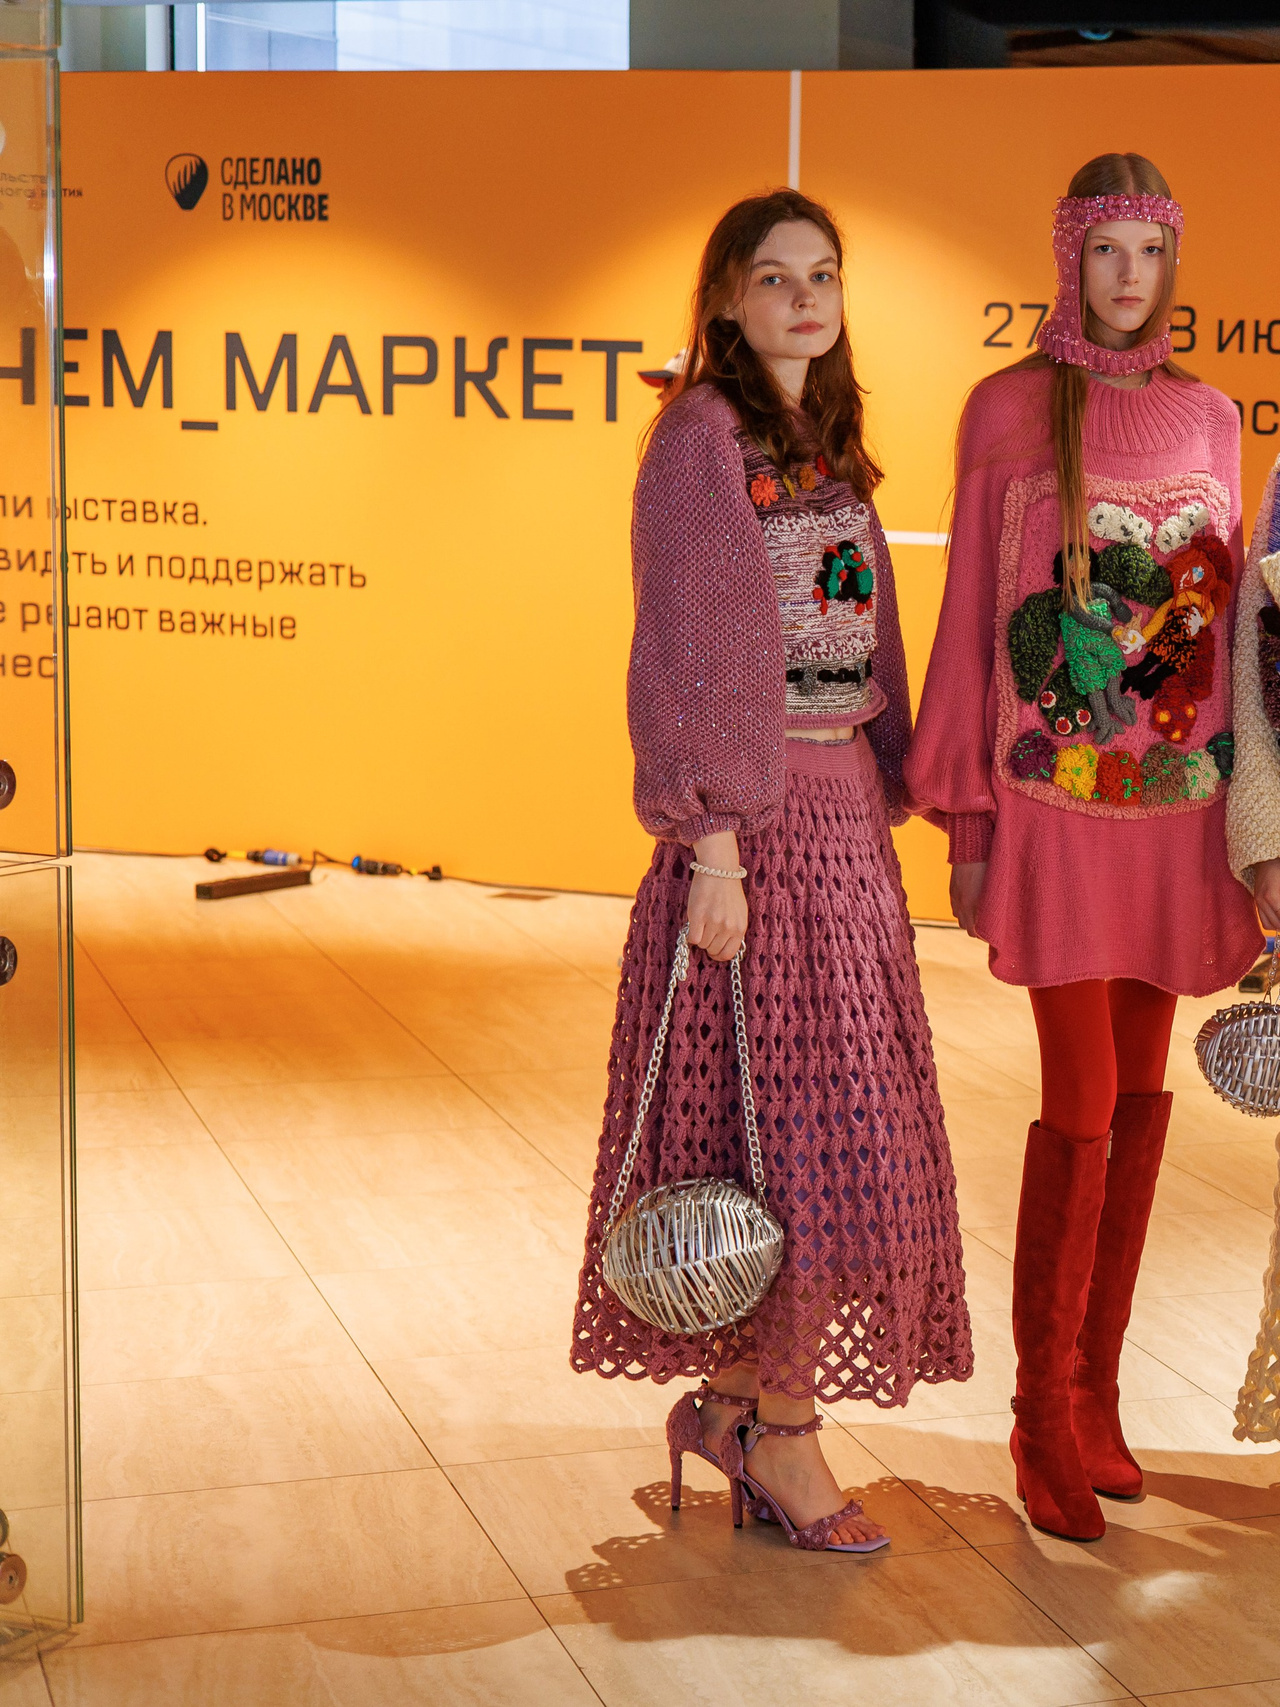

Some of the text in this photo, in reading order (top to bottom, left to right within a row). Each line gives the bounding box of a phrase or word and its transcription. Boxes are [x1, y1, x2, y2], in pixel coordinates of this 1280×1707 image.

[220, 157, 322, 190] СДЕЛАНО
[222, 193, 329, 221] В МОСКВЕ
[984, 303, 1050, 348] 27
[118, 554, 134, 576] и
[146, 554, 367, 589] поддержать
[159, 610, 297, 640] важные
